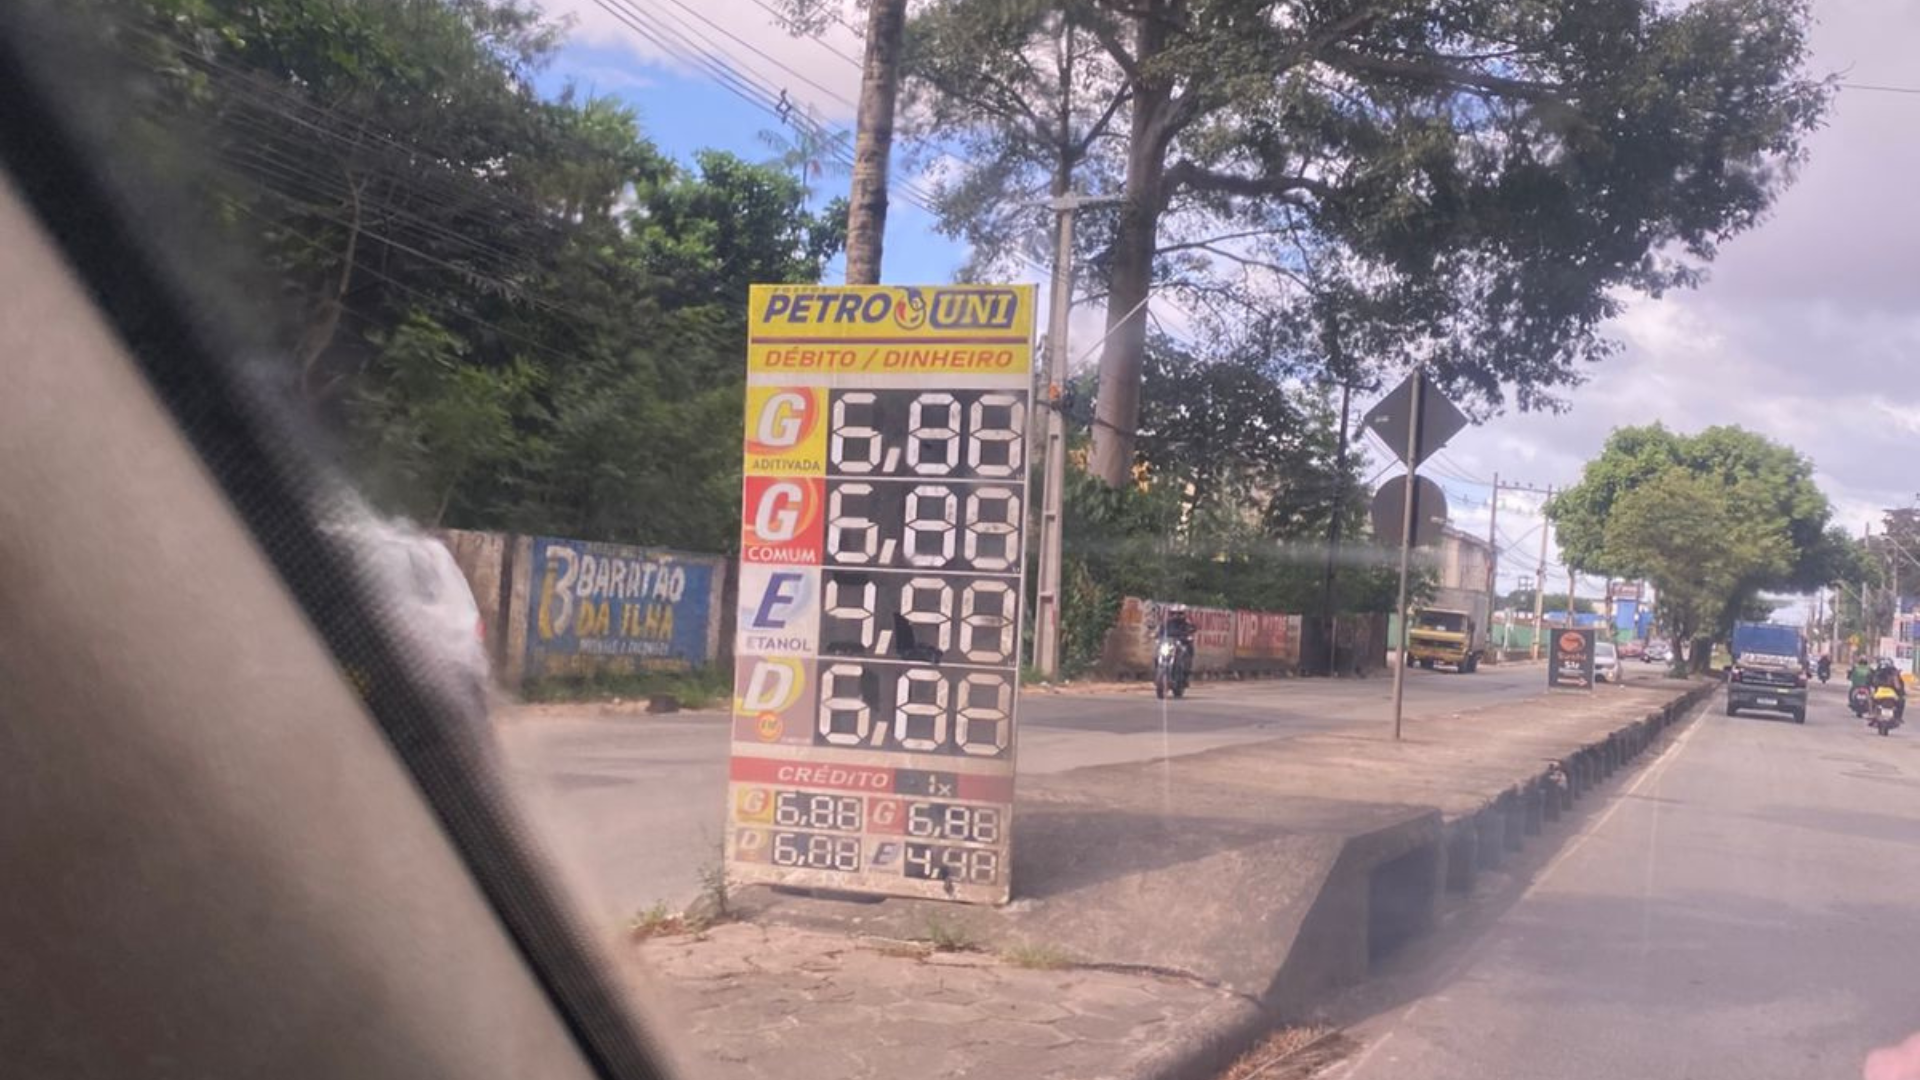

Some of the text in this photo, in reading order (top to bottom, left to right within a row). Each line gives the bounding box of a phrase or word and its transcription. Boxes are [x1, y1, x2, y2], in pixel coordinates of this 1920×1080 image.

[763, 291, 1011, 326] PETRO UNI
[764, 347, 856, 368] DÉBITO
[883, 350, 1014, 368] DINHEIRO
[757, 392, 1025, 477] G 6,88
[753, 459, 820, 471] ADITIVADA
[754, 483, 1020, 570] G 6,88
[748, 547, 816, 563] COMUM
[576, 553, 686, 603] BARATÃO
[752, 572, 803, 628] E
[574, 601, 611, 637] DA
[746, 636, 812, 652] ETANOL
[743, 662, 1011, 755] D 6,88
[778, 764, 889, 789] CRÉDITO
[776, 793, 861, 829] 6,88
[908, 803, 998, 842] 6,88
